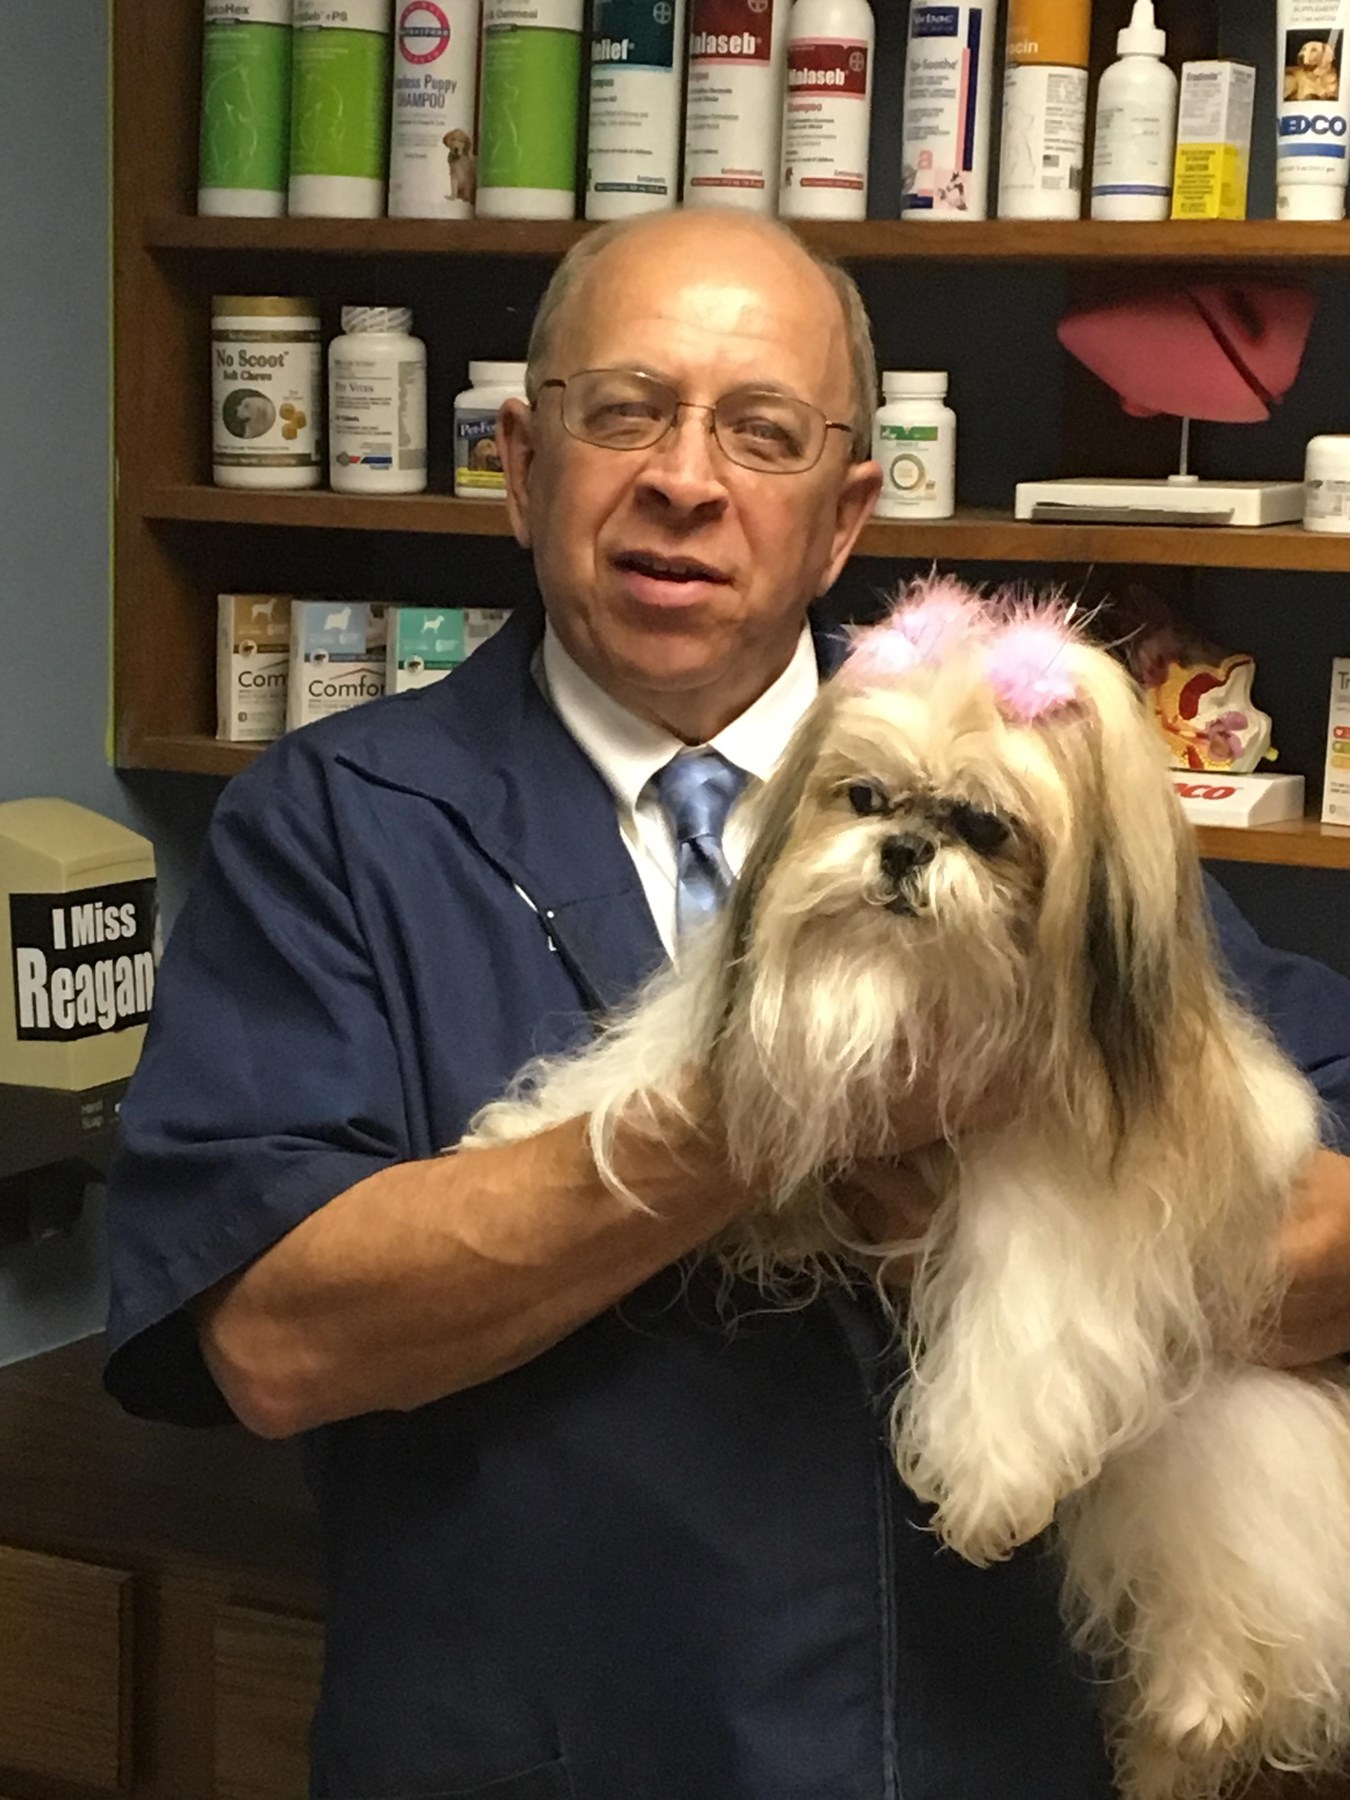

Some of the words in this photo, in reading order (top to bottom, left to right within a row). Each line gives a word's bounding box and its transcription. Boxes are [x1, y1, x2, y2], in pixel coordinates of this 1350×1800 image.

[689, 31, 756, 55] alaseb
[424, 74, 458, 94] Puppy
[215, 349, 234, 367] No
[238, 671, 286, 688] Com
[52, 908, 66, 949] I
[71, 902, 137, 948] Miss
[16, 947, 154, 1030] Reagan
